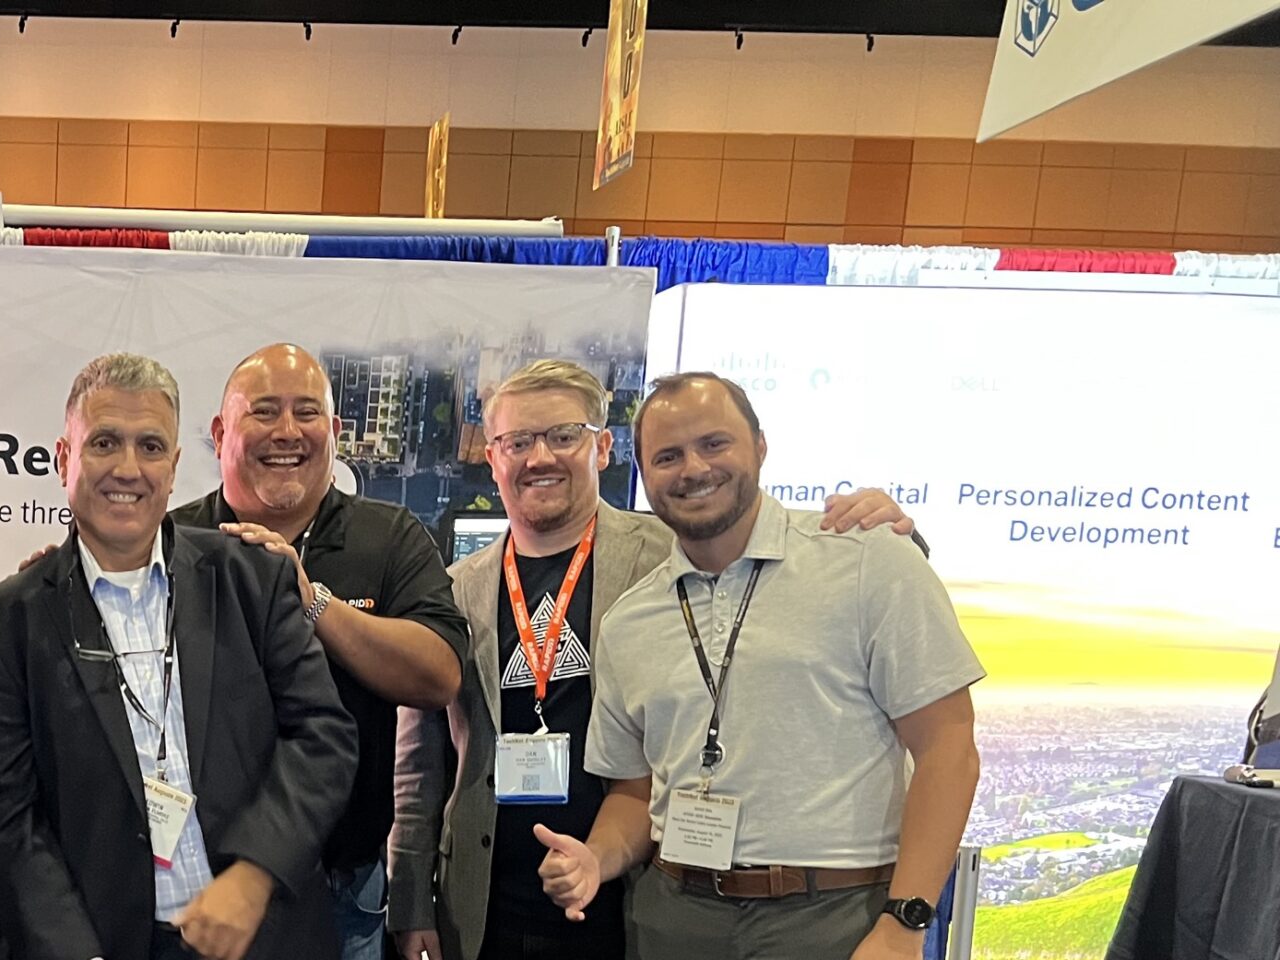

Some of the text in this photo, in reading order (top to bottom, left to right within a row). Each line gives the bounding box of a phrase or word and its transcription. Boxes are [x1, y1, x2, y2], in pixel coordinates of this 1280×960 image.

[957, 483, 1251, 512] Personalized Content
[1009, 519, 1190, 549] Development
